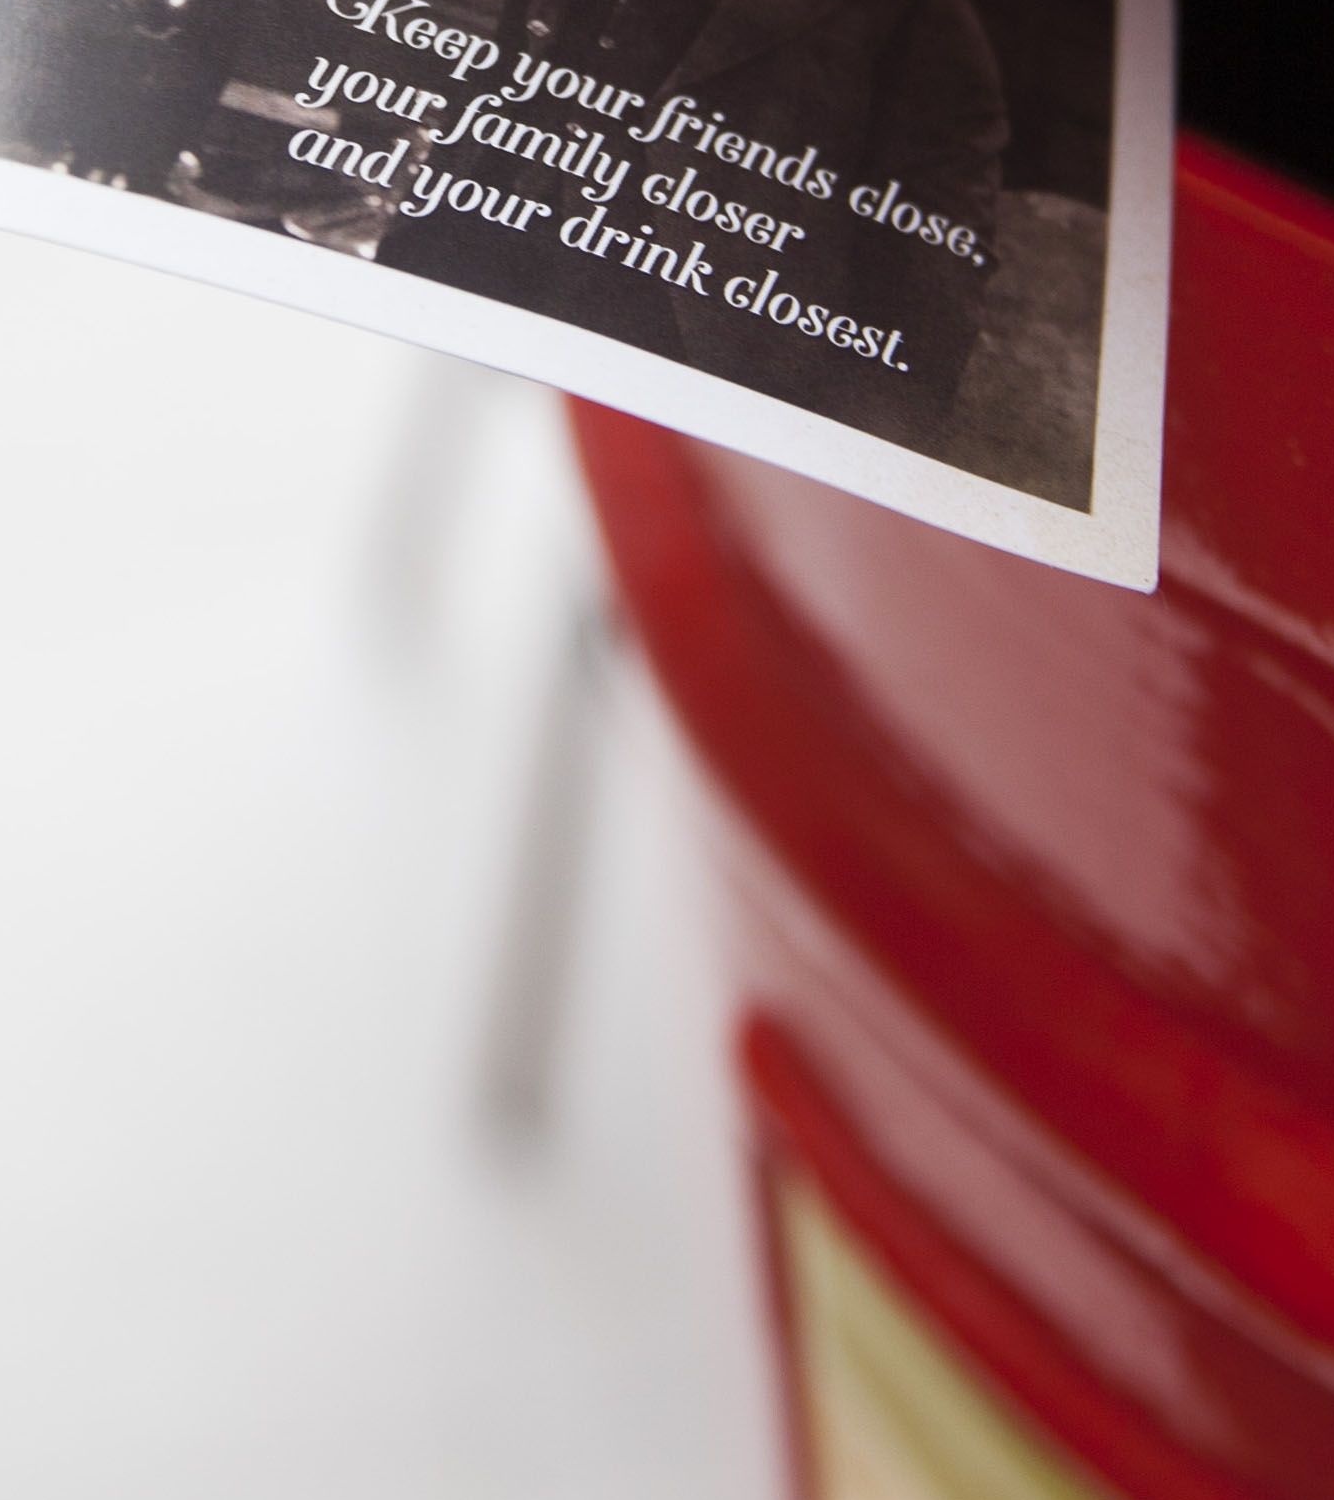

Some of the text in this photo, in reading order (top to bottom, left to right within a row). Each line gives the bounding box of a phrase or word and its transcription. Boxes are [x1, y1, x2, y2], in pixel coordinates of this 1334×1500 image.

[286, 127, 911, 374] and your drink closest.
[293, 55, 807, 256] your family closer
[499, 50, 646, 123] your
[628, 95, 839, 201] friends
[847, 180, 987, 268] close,
